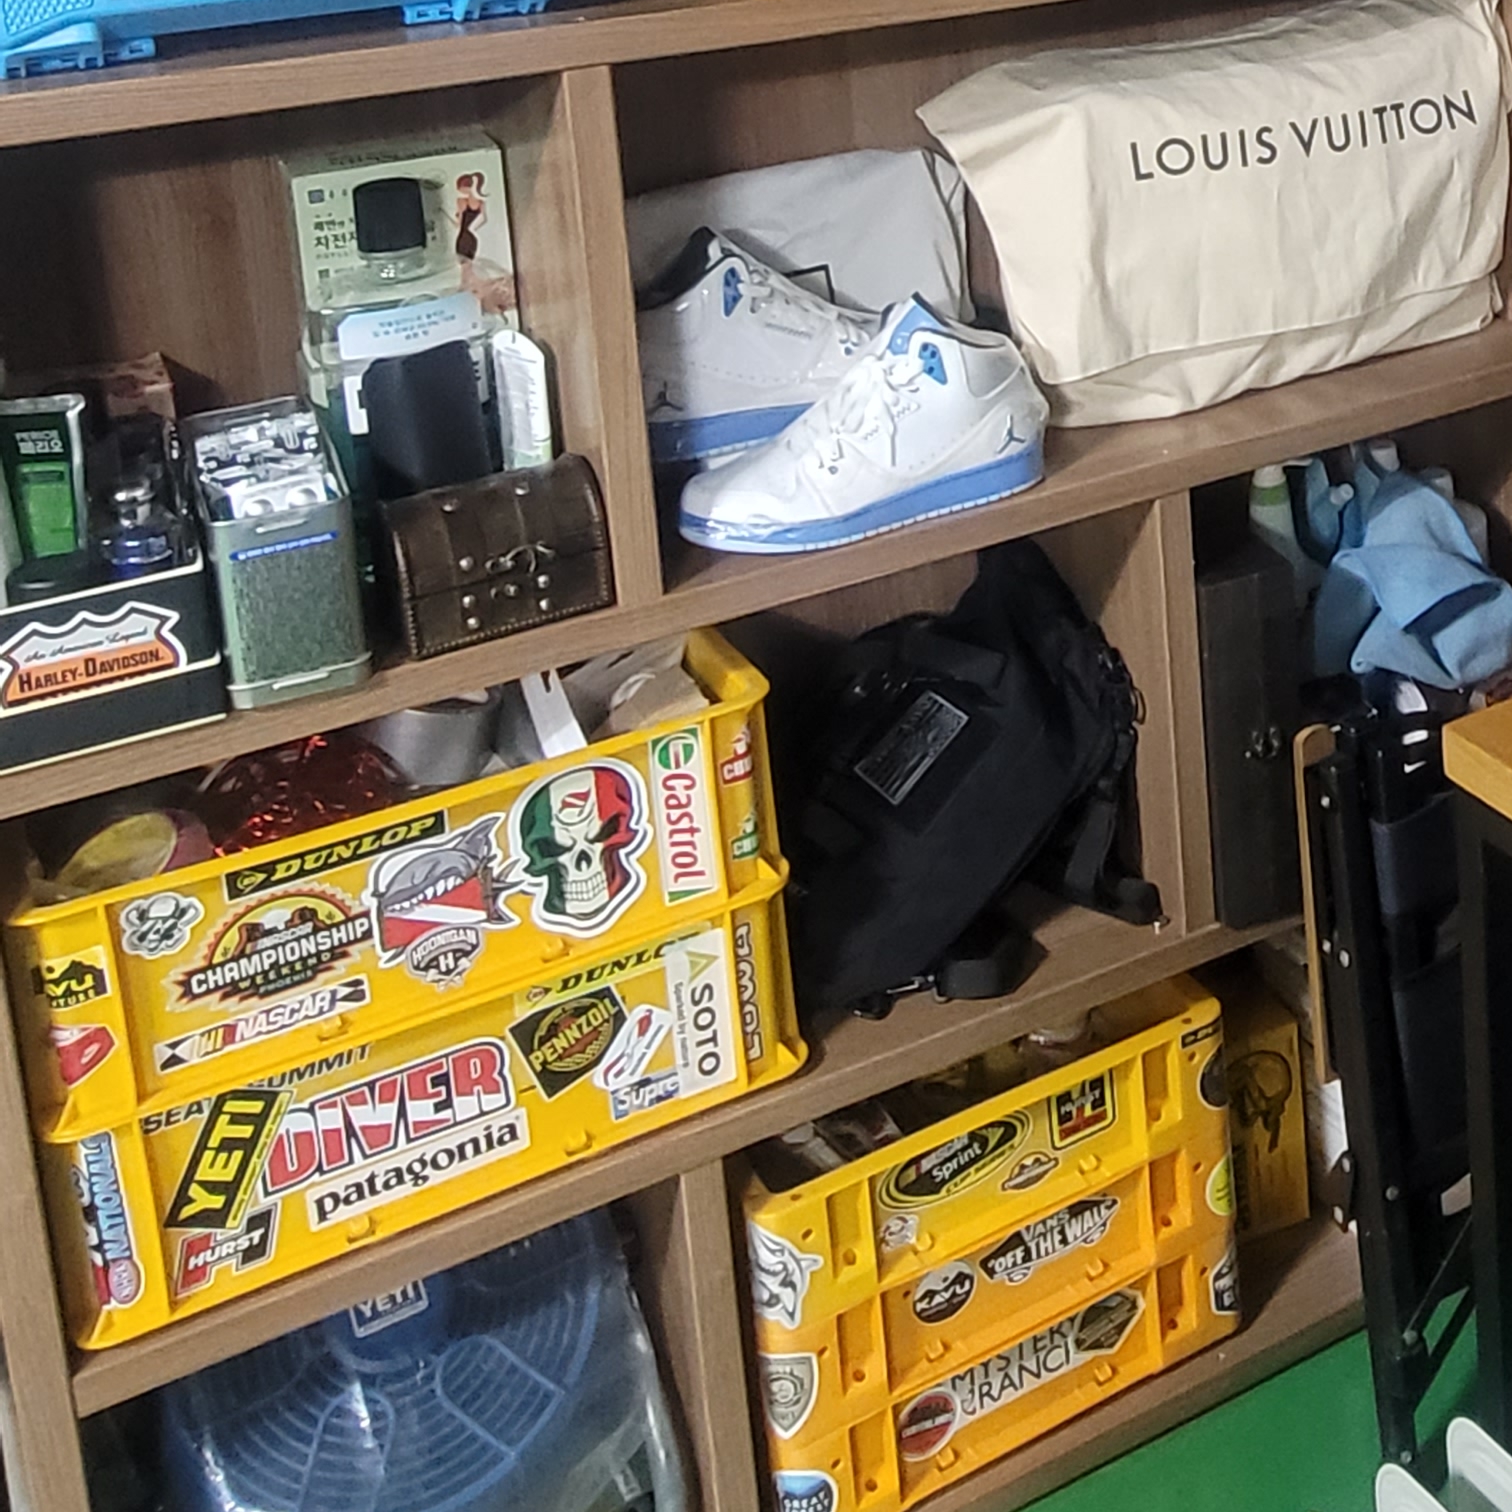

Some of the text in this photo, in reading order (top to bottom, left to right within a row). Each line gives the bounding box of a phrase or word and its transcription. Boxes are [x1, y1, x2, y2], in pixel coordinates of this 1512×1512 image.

[1130, 88, 1479, 182] LOUIS VUITTON
[18, 648, 161, 693] HARLEY-DAVIDSON
[270, 816, 436, 880] DUNLOP
[662, 772, 706, 884] Castrol
[190, 917, 369, 994] CHAMPIONSHIP
[238, 953, 332, 989] WEEKEND
[412, 927, 477, 963] HOONIGAN
[235, 989, 336, 1042] NASCAR
[529, 997, 620, 1073] PENNZOIL
[690, 982, 721, 1076] SOTO
[142, 1100, 205, 1134] SEA
[266, 1045, 502, 1190] DIVER
[178, 1100, 265, 1221] YETI
[314, 1118, 520, 1224] patagonia
[932, 1142, 982, 1182] Sprint
[188, 1228, 265, 1270] HURST
[1021, 1210, 1071, 1240] VANS
[1028, 1228, 1064, 1260] THE
[915, 1277, 970, 1312] KAVU
